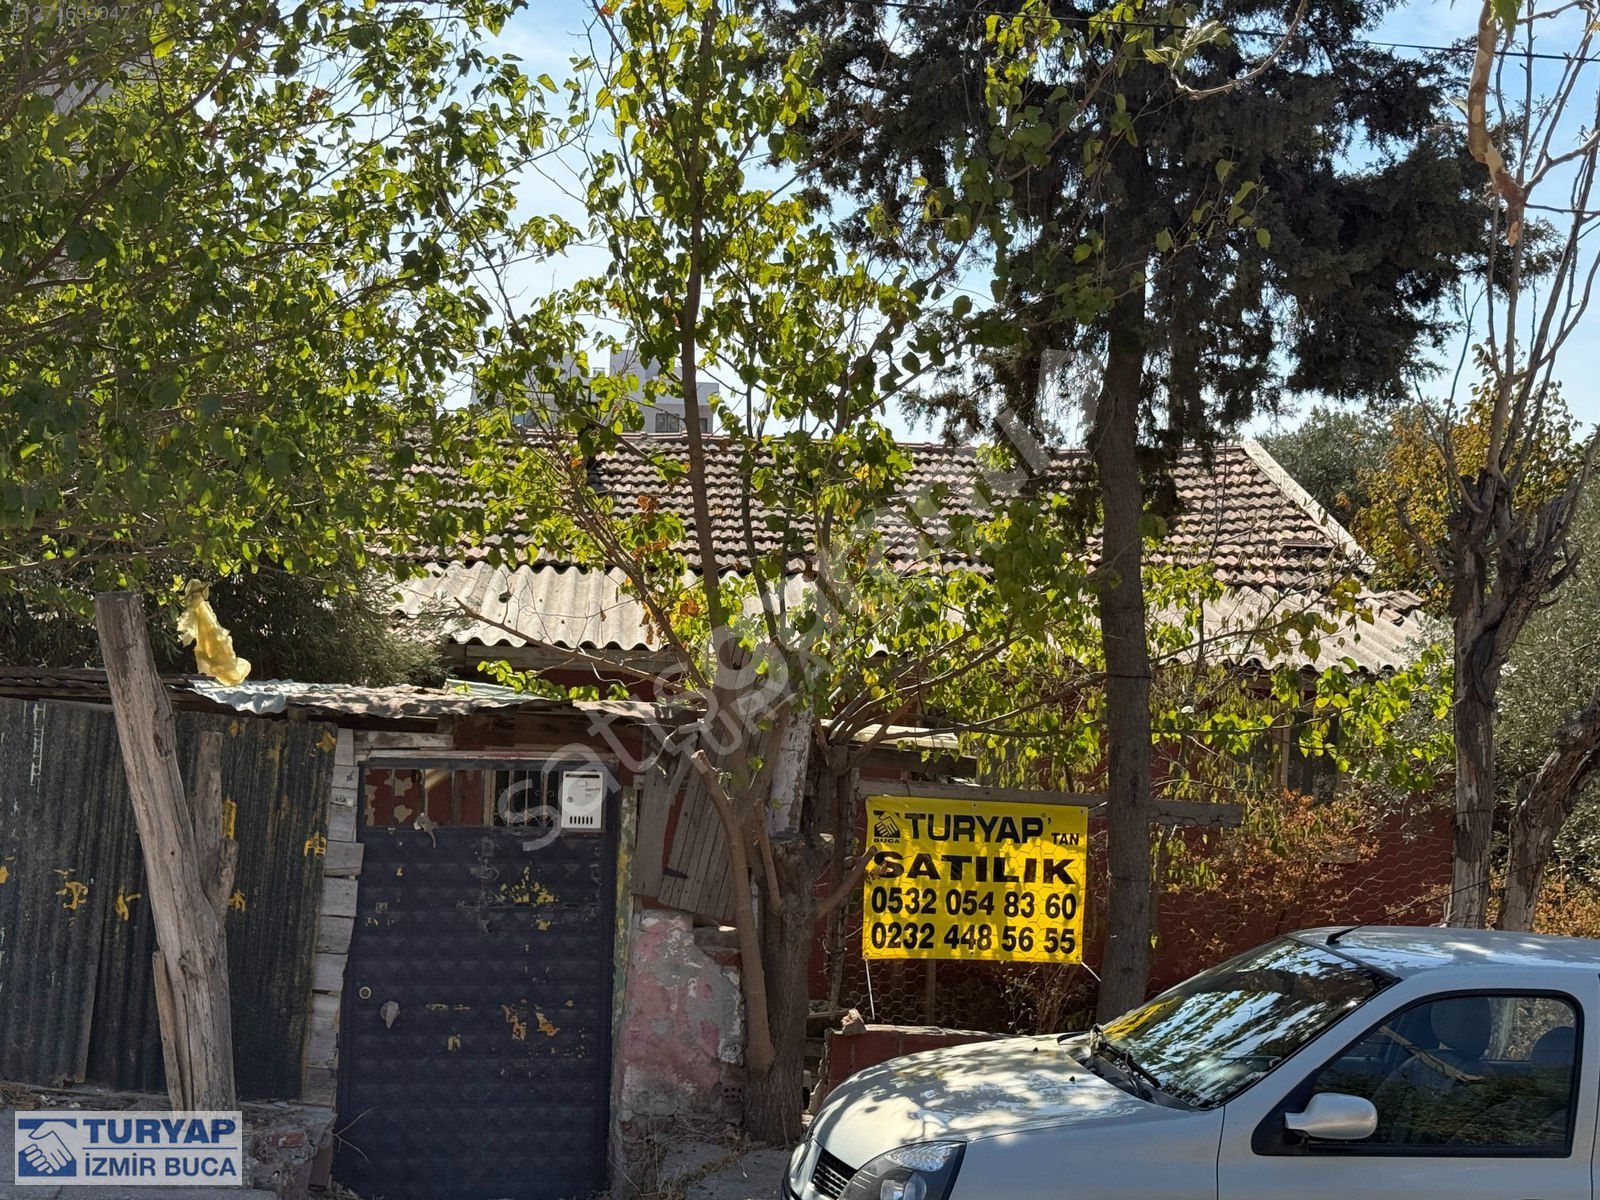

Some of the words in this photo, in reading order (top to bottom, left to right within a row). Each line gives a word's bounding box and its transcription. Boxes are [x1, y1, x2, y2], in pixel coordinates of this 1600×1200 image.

[1051, 832, 1079, 846] TAN
[873, 851, 1076, 885] SATILIK
[871, 886, 937, 915] 0532
[945, 888, 995, 916] 054
[1003, 891, 1035, 919] 83
[1045, 893, 1077, 920] 60
[871, 922, 935, 950] 0232
[944, 924, 992, 951] 448
[1001, 925, 1034, 952] 56
[1043, 928, 1075, 954] 55
